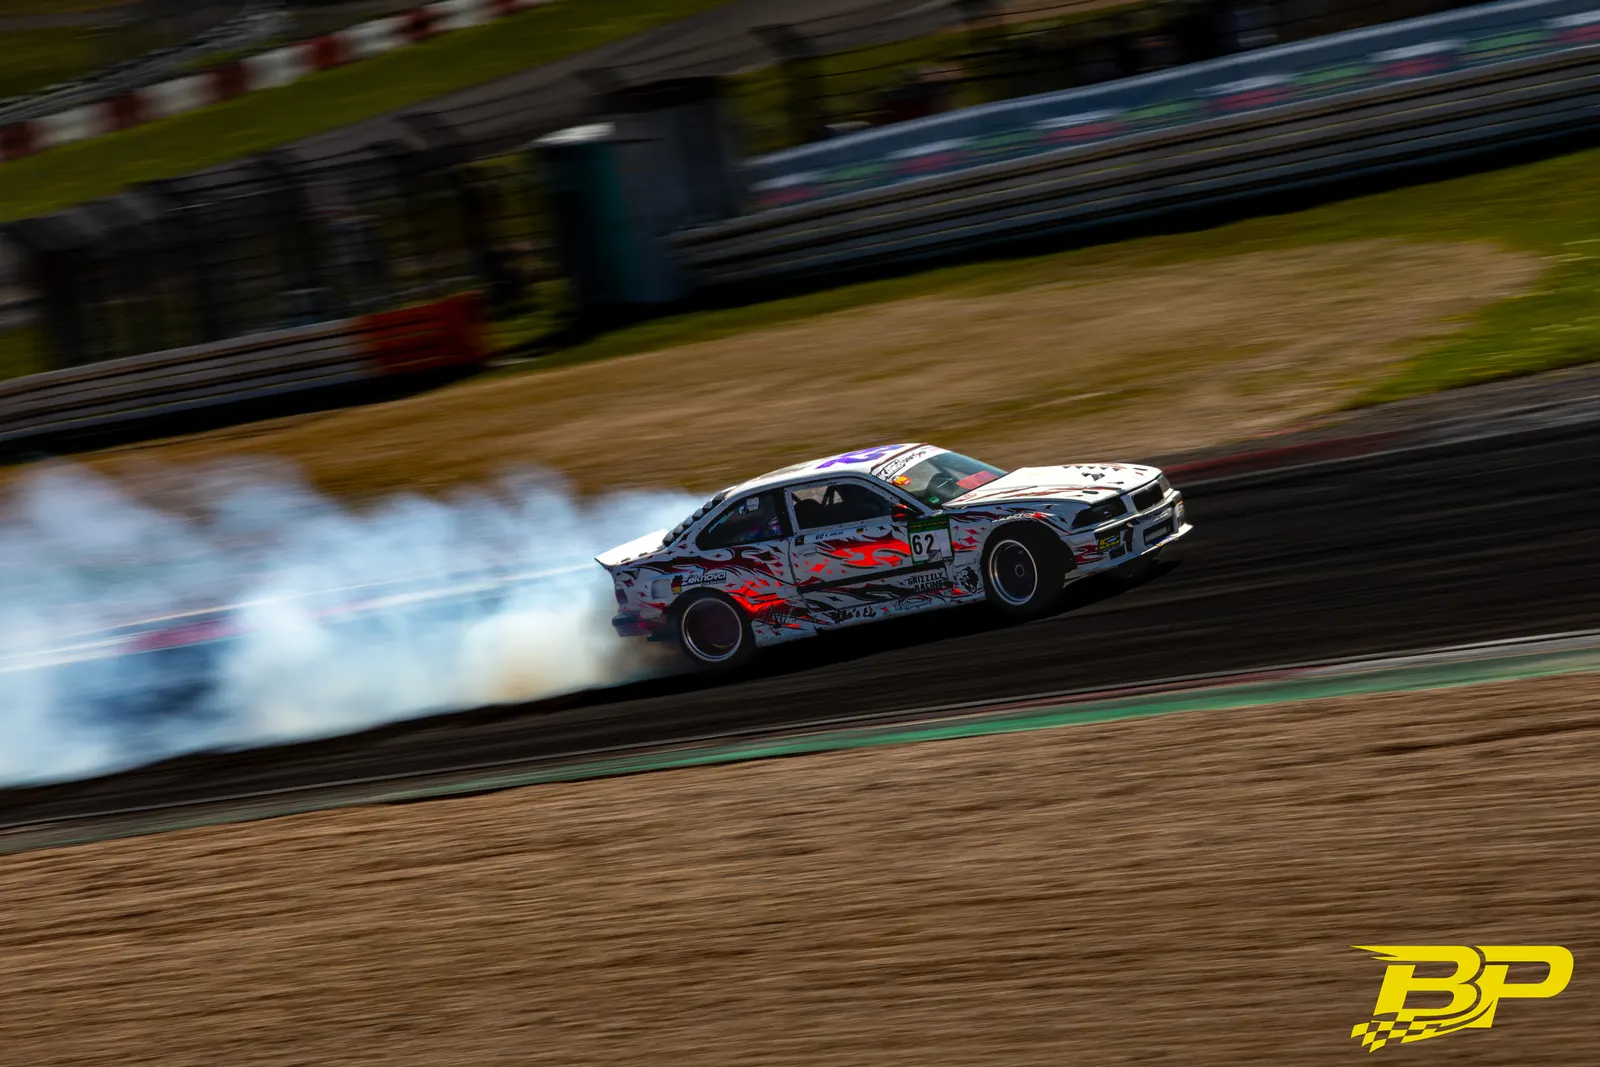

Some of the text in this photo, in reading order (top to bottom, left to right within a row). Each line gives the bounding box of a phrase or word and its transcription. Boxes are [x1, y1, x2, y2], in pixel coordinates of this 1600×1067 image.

[912, 533, 935, 555] 62
[907, 571, 943, 586] GRIZZZLY
[914, 580, 944, 592] RACING
